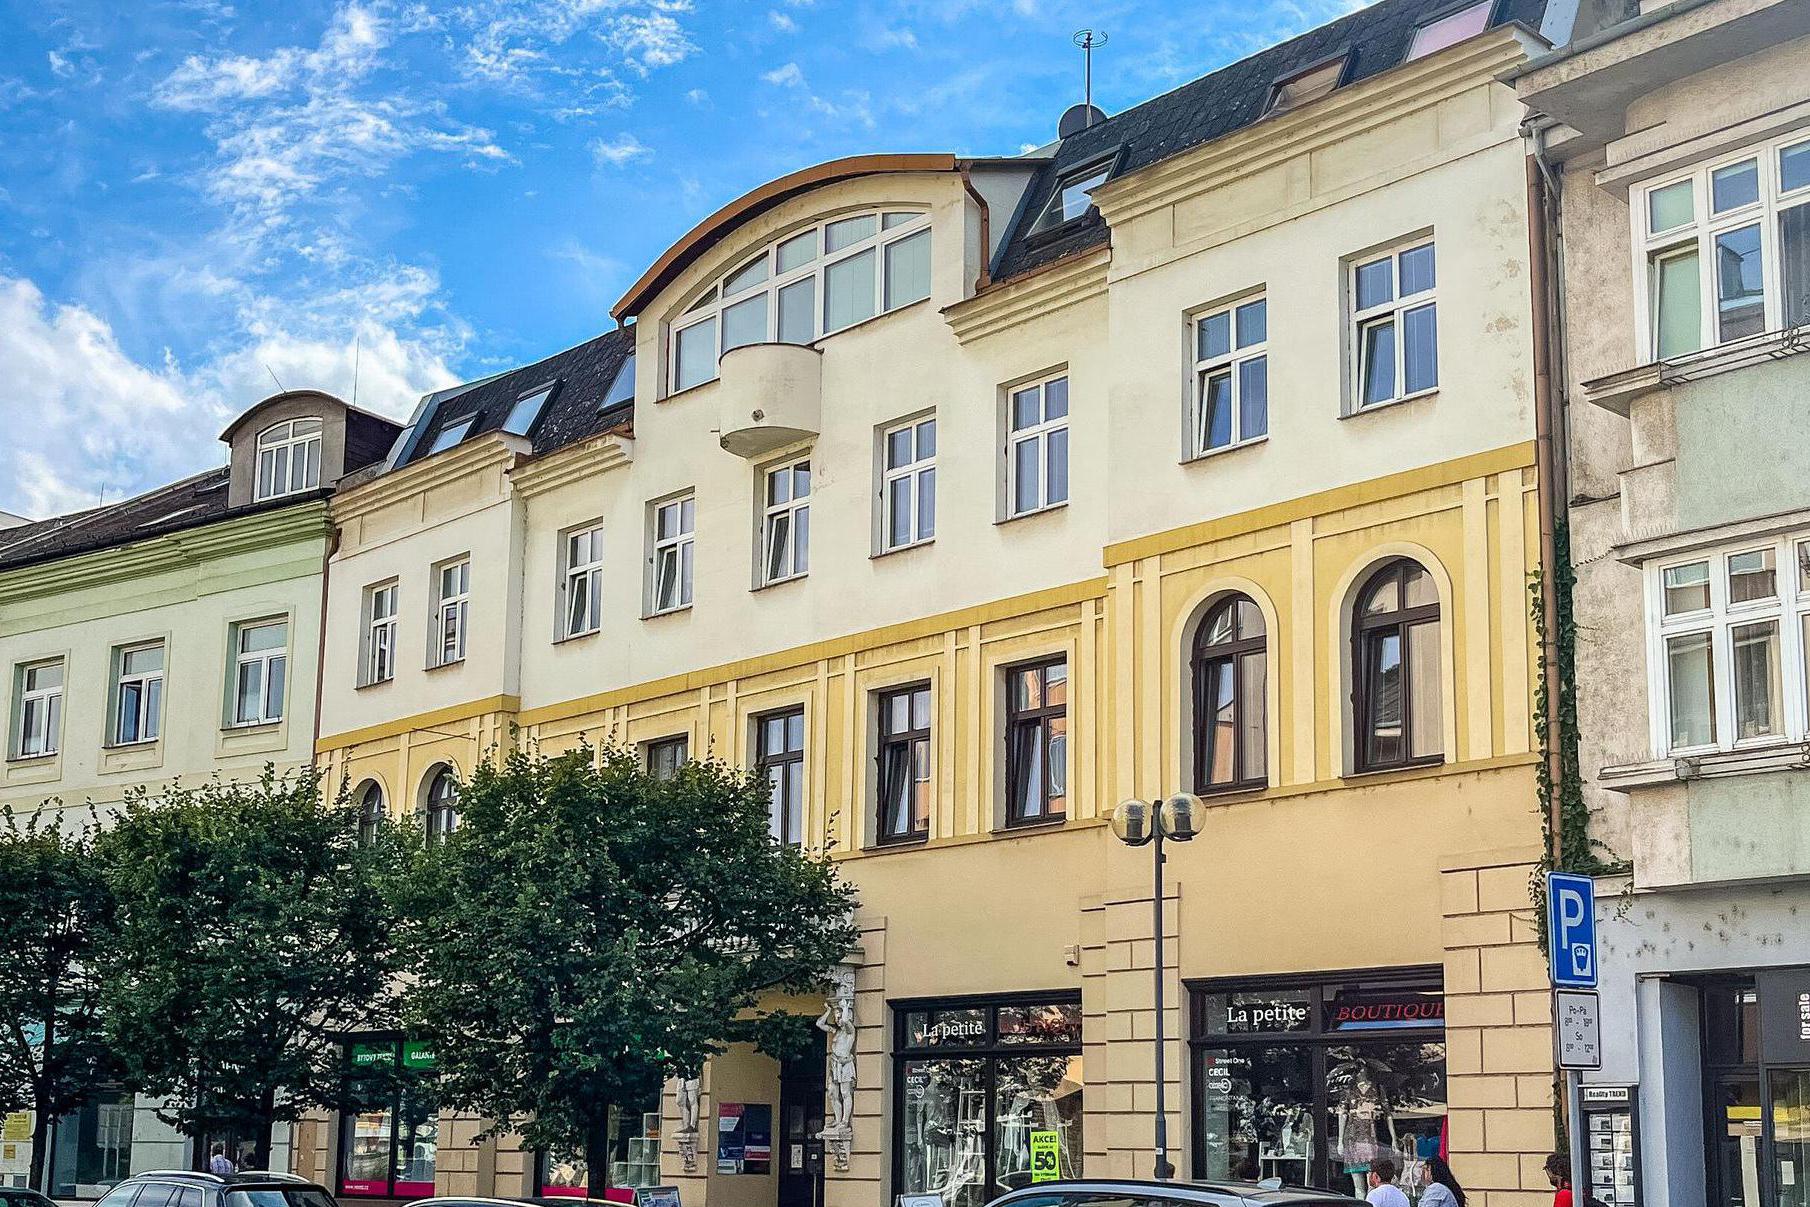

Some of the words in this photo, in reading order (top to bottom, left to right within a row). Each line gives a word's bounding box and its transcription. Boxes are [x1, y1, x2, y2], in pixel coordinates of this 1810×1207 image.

[1560, 889, 1584, 949] P
[1226, 1007, 1248, 1023] La
[1252, 1004, 1306, 1026] petite
[1798, 993, 1810, 1020] sale
[923, 1023, 939, 1037] La
[942, 1021, 982, 1039] petite
[1799, 1022, 1810, 1040] for
[1209, 1068, 1230, 1077] CECIL
[1033, 1135, 1057, 1143] AKCE!
